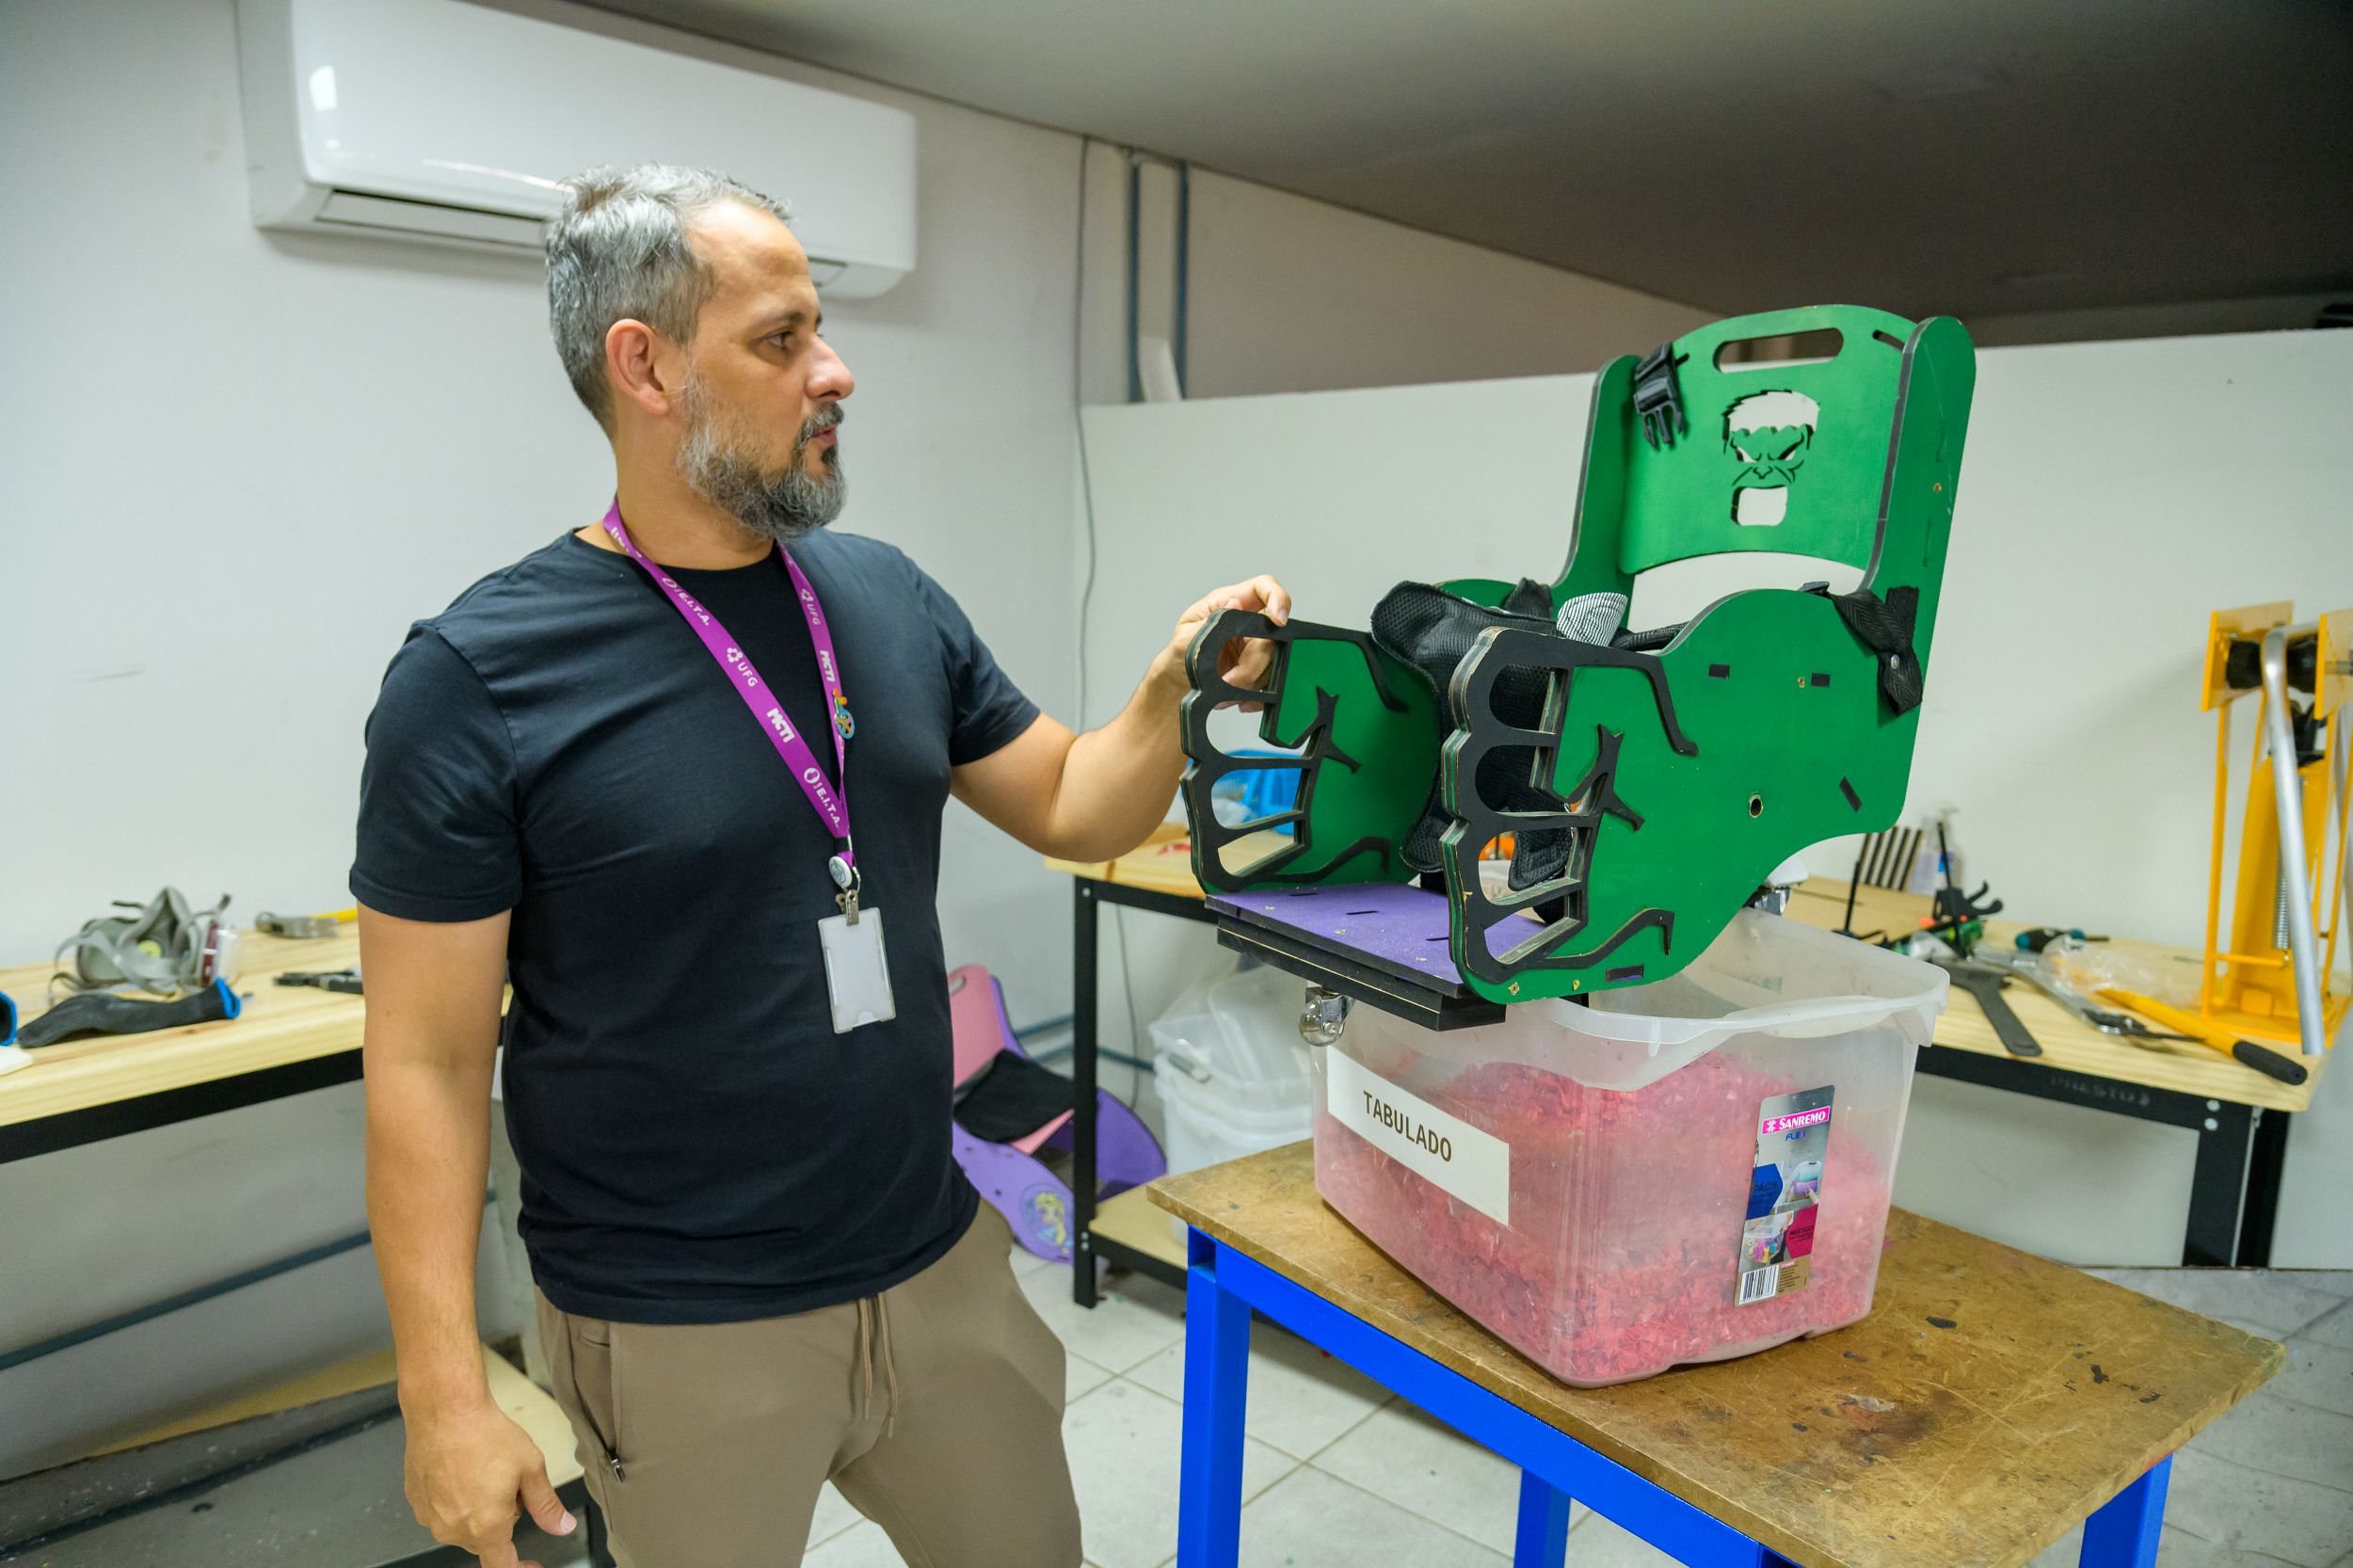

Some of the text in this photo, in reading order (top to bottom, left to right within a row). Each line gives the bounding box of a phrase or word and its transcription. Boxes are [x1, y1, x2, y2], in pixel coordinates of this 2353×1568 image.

[807, 603, 821, 626] UFG
[737, 661, 759, 687] UFG
[816, 788, 840, 828] E.I.T.A.
[1363, 1090, 1452, 1162] TABULADO
[1778, 1111, 1827, 1130] SANREMO
